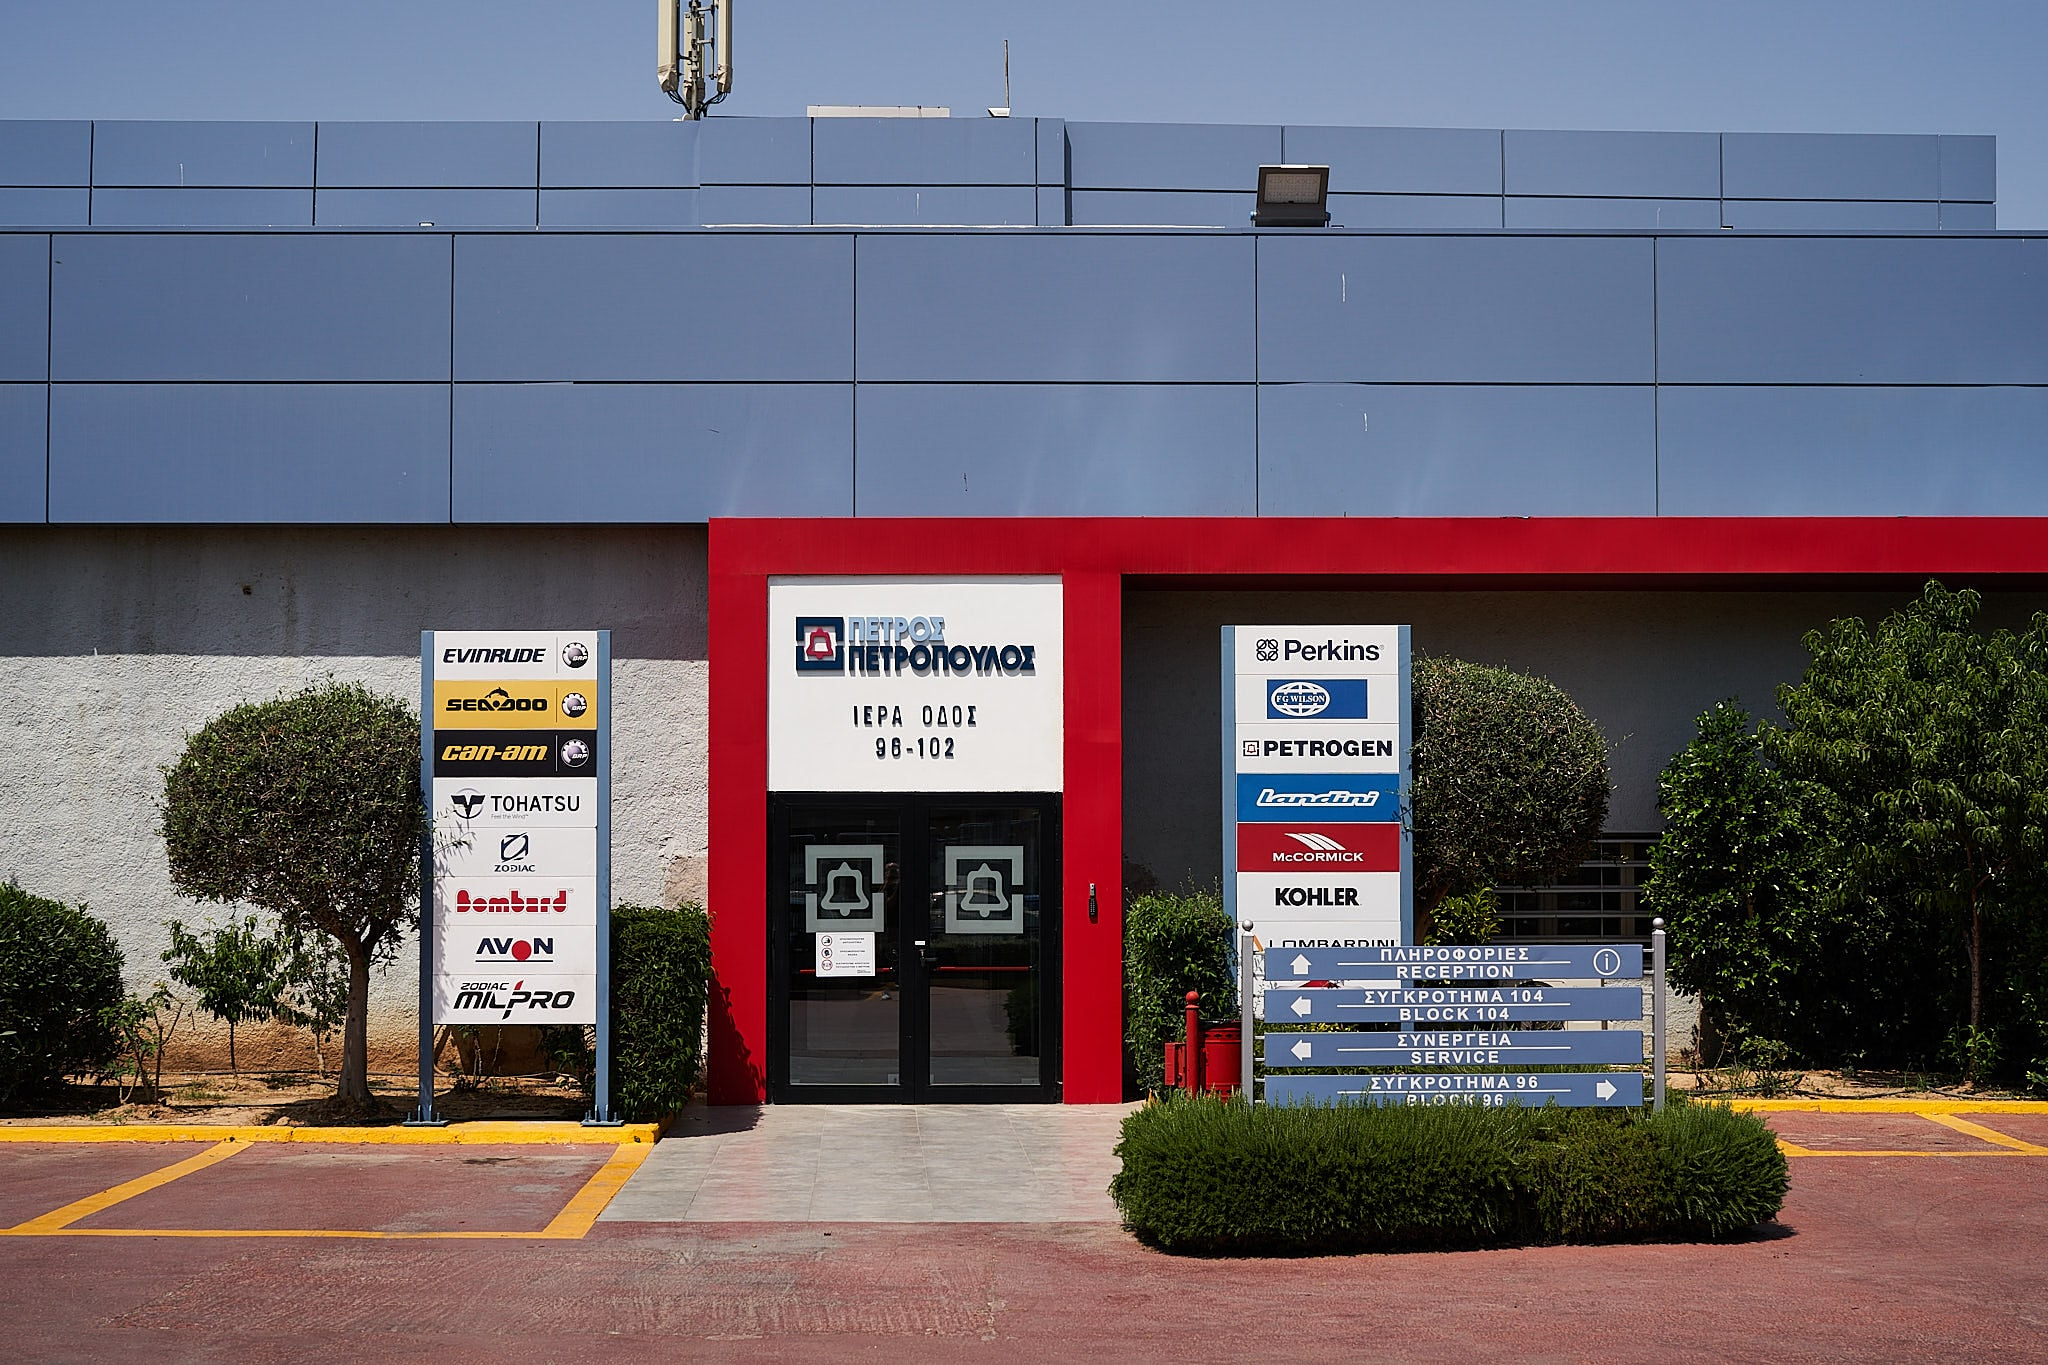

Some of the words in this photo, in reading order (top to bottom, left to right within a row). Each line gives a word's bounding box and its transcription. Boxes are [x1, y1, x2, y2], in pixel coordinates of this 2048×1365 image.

[849, 617, 943, 641] ΠΕΤΡΟΣ
[849, 645, 1035, 672] ΠΕΤΡΟΠΟΥΛΟΣ
[1276, 695, 1288, 703] FG
[1291, 695, 1325, 703] WILSON
[853, 705, 903, 726] ΙΕΡΑ
[922, 705, 977, 726] ΟΔΟΣ
[875, 737, 955, 759] 96-102
[1263, 739, 1393, 757] PETROGEN
[490, 795, 580, 812] TOHATSU
[1256, 788, 1380, 806] Landini
[494, 864, 536, 873] ZODIAC
[1275, 887, 1360, 906] KOHLER
[1380, 948, 1530, 962] ΠΛΗΡΟΦΟΡΙΕΣ
[1396, 965, 1515, 979] RECEPTION
[460, 982, 510, 990] ZODIAC
[1364, 990, 1503, 1005] ΣΥΓΚΡΟΤΗΜΑ
[1510, 989, 1544, 1002] 104
[1400, 1008, 1469, 1021] BLOCK
[1476, 1007, 1510, 1020] 104
[1396, 1033, 1513, 1047] ΣΥΝΕΡΓΕΙΑ
[1410, 1050, 1500, 1065] SERVICE
[1371, 1076, 1510, 1090] ΣΥΓΚΡΟΤΗΜΑ
[1516, 1075, 1538, 1089] 96
[1482, 1093, 1504, 1106] 96
